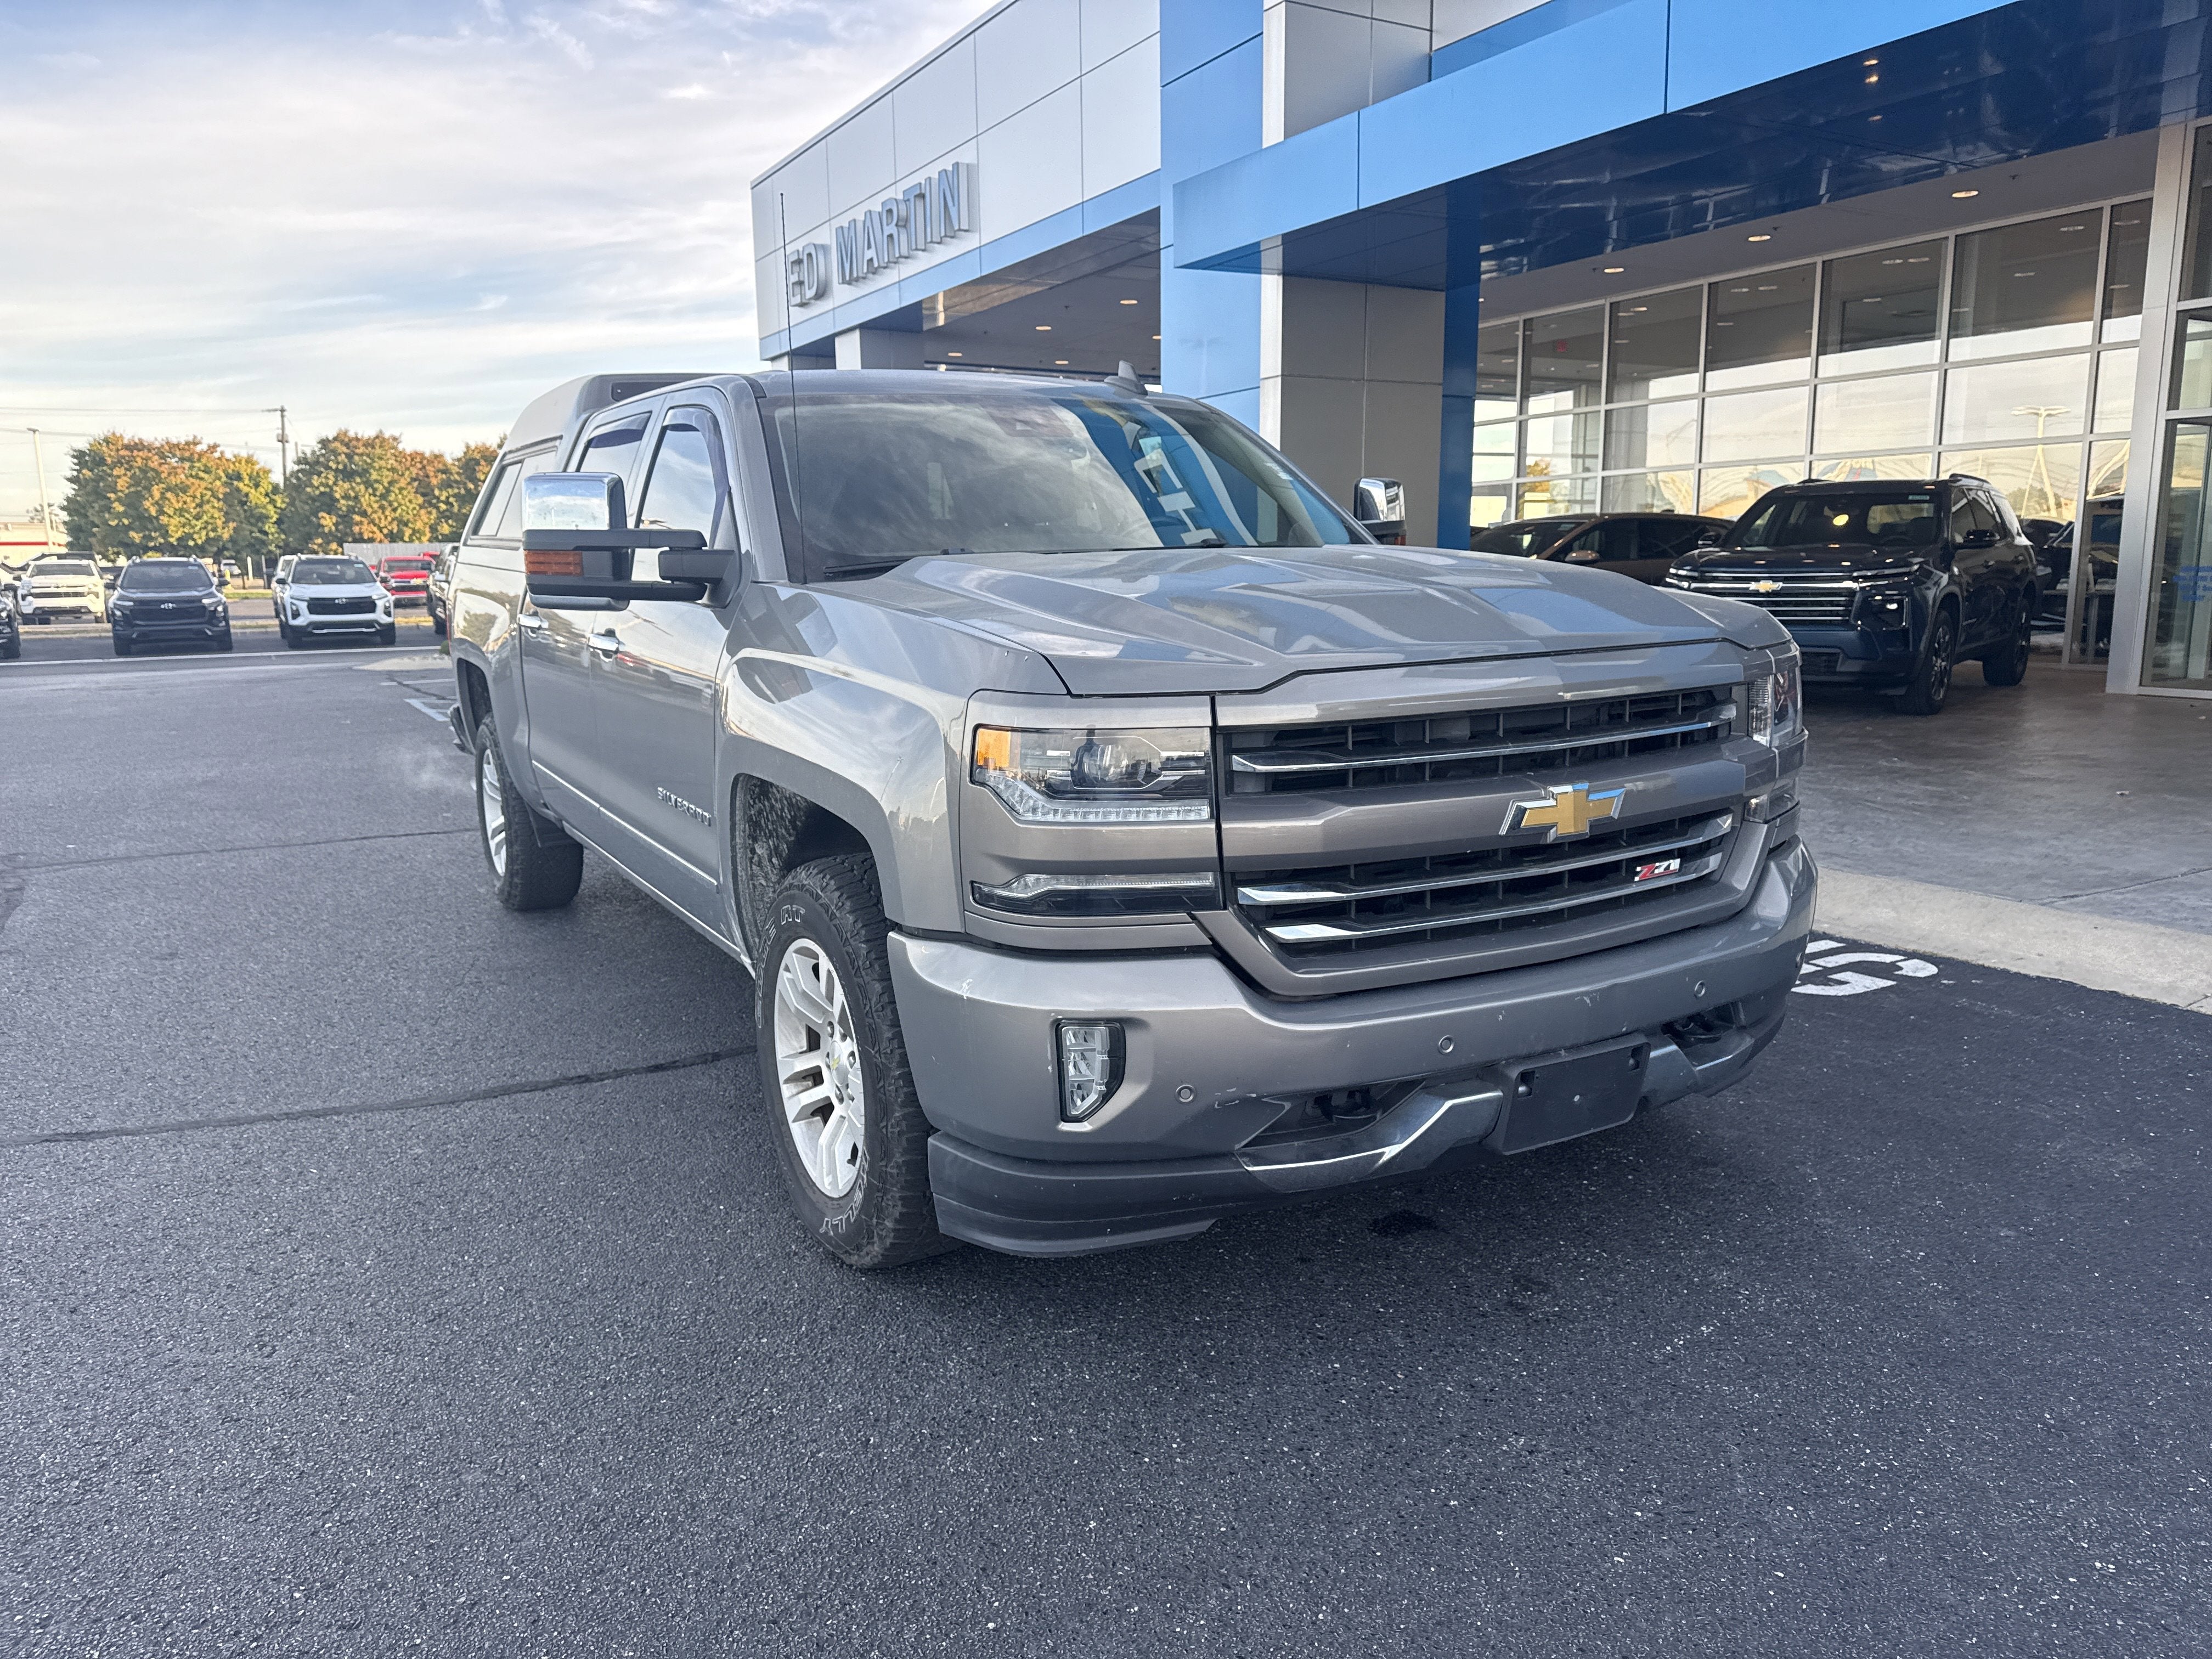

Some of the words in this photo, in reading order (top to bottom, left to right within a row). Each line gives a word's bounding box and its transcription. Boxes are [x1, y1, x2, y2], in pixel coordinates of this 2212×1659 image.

[787, 242, 827, 308] ED
[835, 161, 969, 286] MARTIN
[657, 787, 712, 827] SILVERADO
[1634, 858, 1681, 882] Z71
[780, 904, 805, 926] AT
